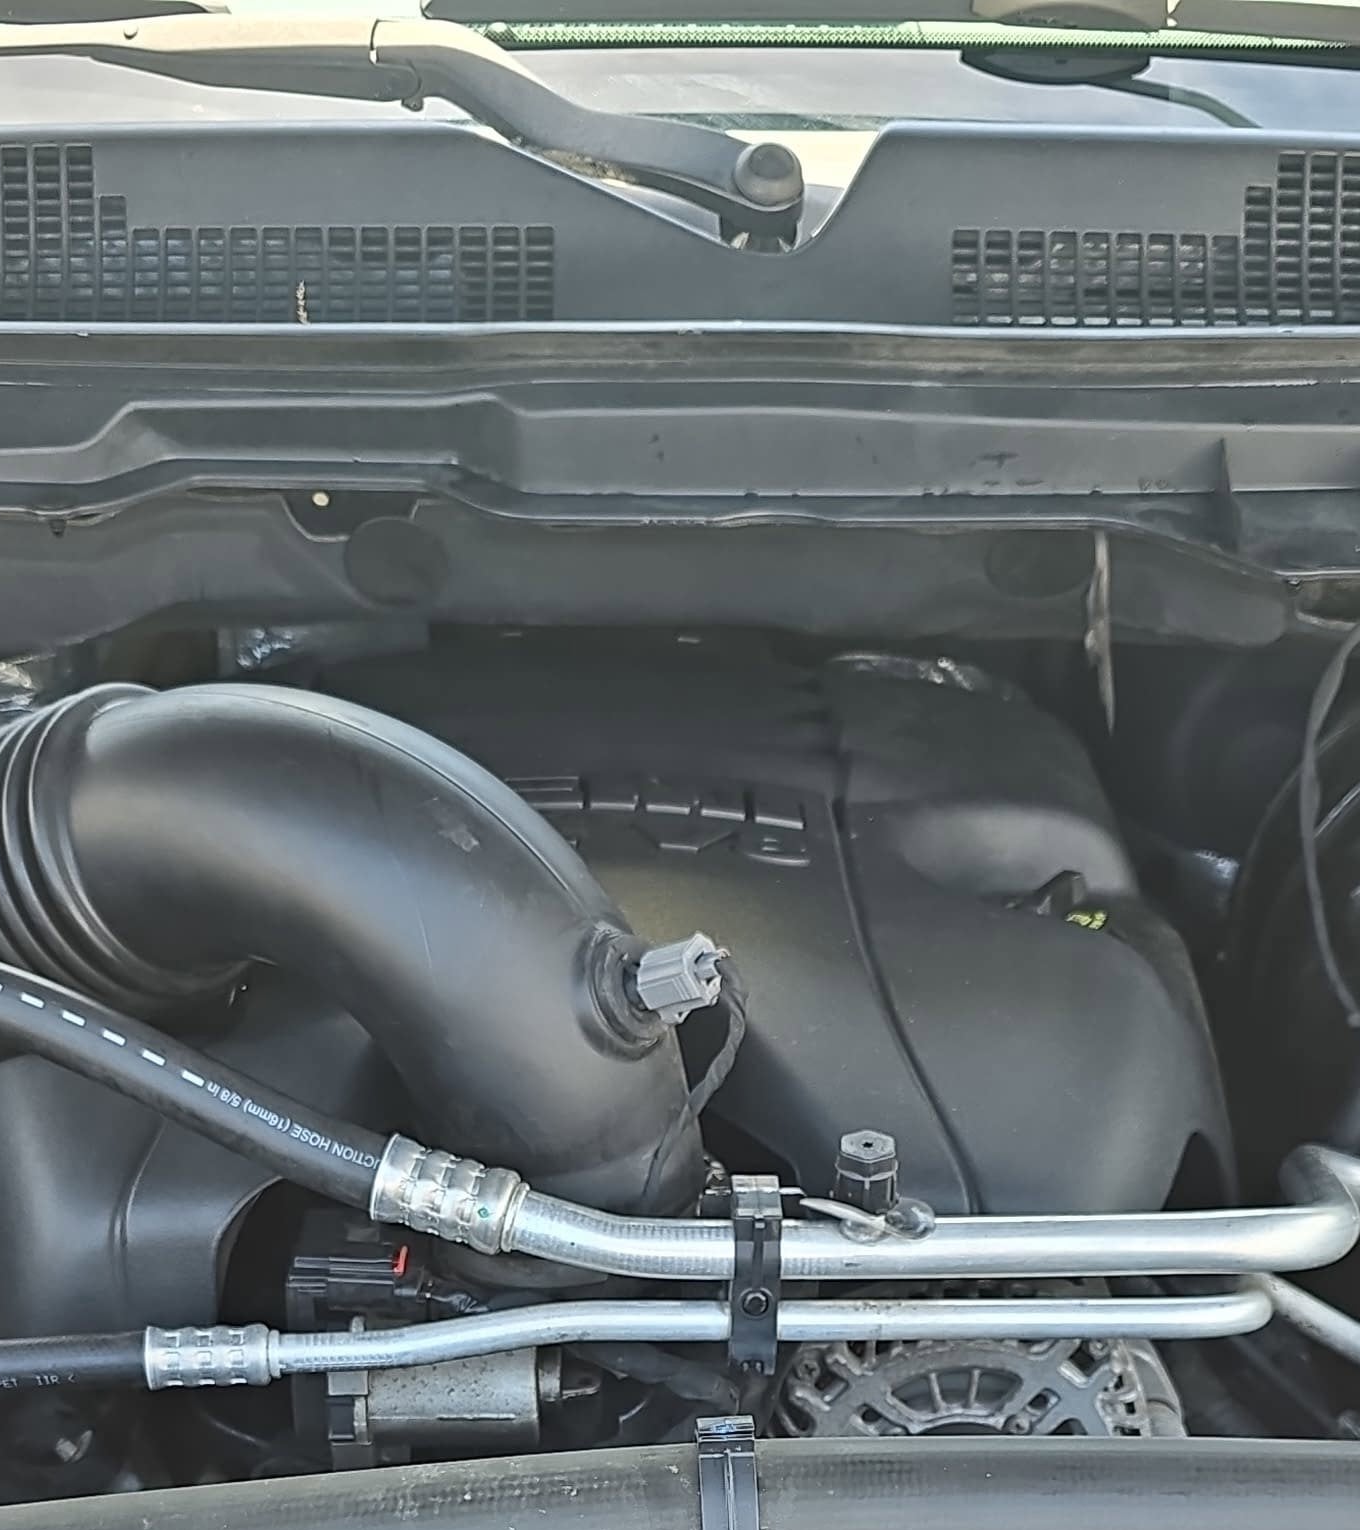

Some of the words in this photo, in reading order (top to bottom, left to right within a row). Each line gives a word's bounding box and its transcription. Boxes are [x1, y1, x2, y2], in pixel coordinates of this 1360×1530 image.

[220, 1087, 243, 1108] 5/8
[242, 1098, 291, 1134] (16mm)
[289, 1123, 333, 1152] HOSE
